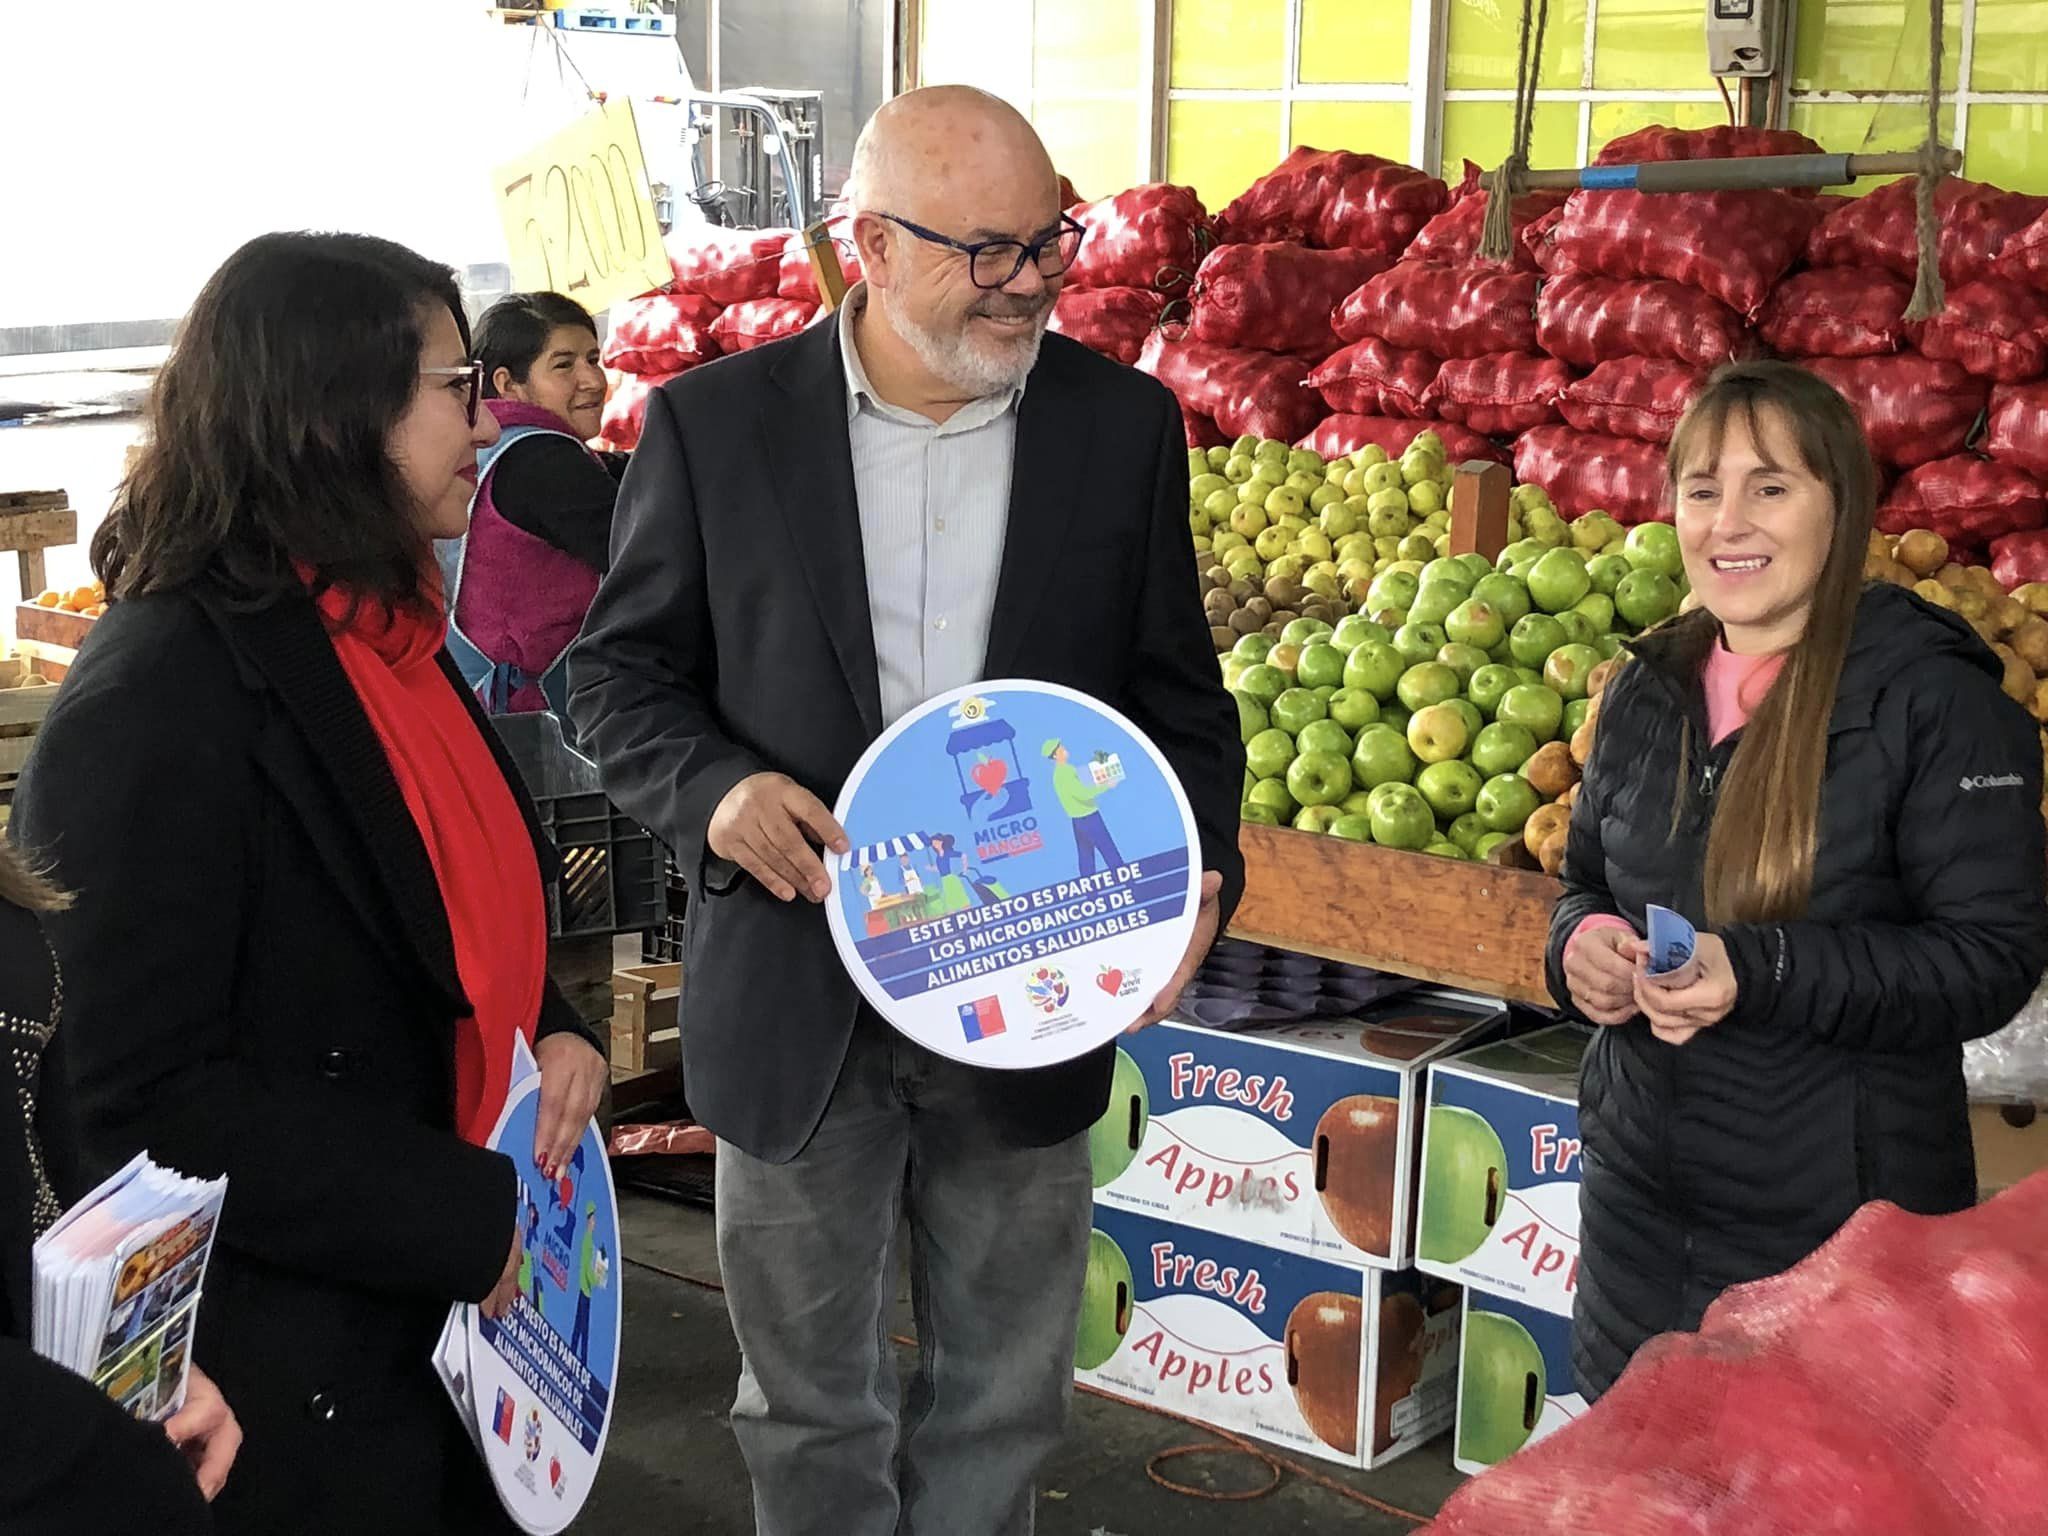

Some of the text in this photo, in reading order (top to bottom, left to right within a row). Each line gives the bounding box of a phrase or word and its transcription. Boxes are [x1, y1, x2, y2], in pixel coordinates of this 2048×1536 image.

[974, 816, 1037, 846] MICRO
[909, 863, 1142, 943] ESTE PUESTO ES PARTE DE
[929, 889, 1135, 962] LOS MICROBANCOS DE
[928, 909, 1149, 988] ALIMENTOS SALUDABLES
[1169, 1052, 1294, 1121] Fresh
[1145, 1144, 1300, 1207] Apples
[1530, 1124, 1583, 1174] Fr
[1151, 1241, 1266, 1314] Fresh
[518, 1294, 592, 1390] PUESTO ES PARTE DE
[518, 1324, 573, 1397] MICROBANCOS
[573, 1385, 584, 1411] DE
[1132, 1331, 1273, 1395] Apples
[494, 1331, 584, 1440] ALIMENTOS SALUDABLES
